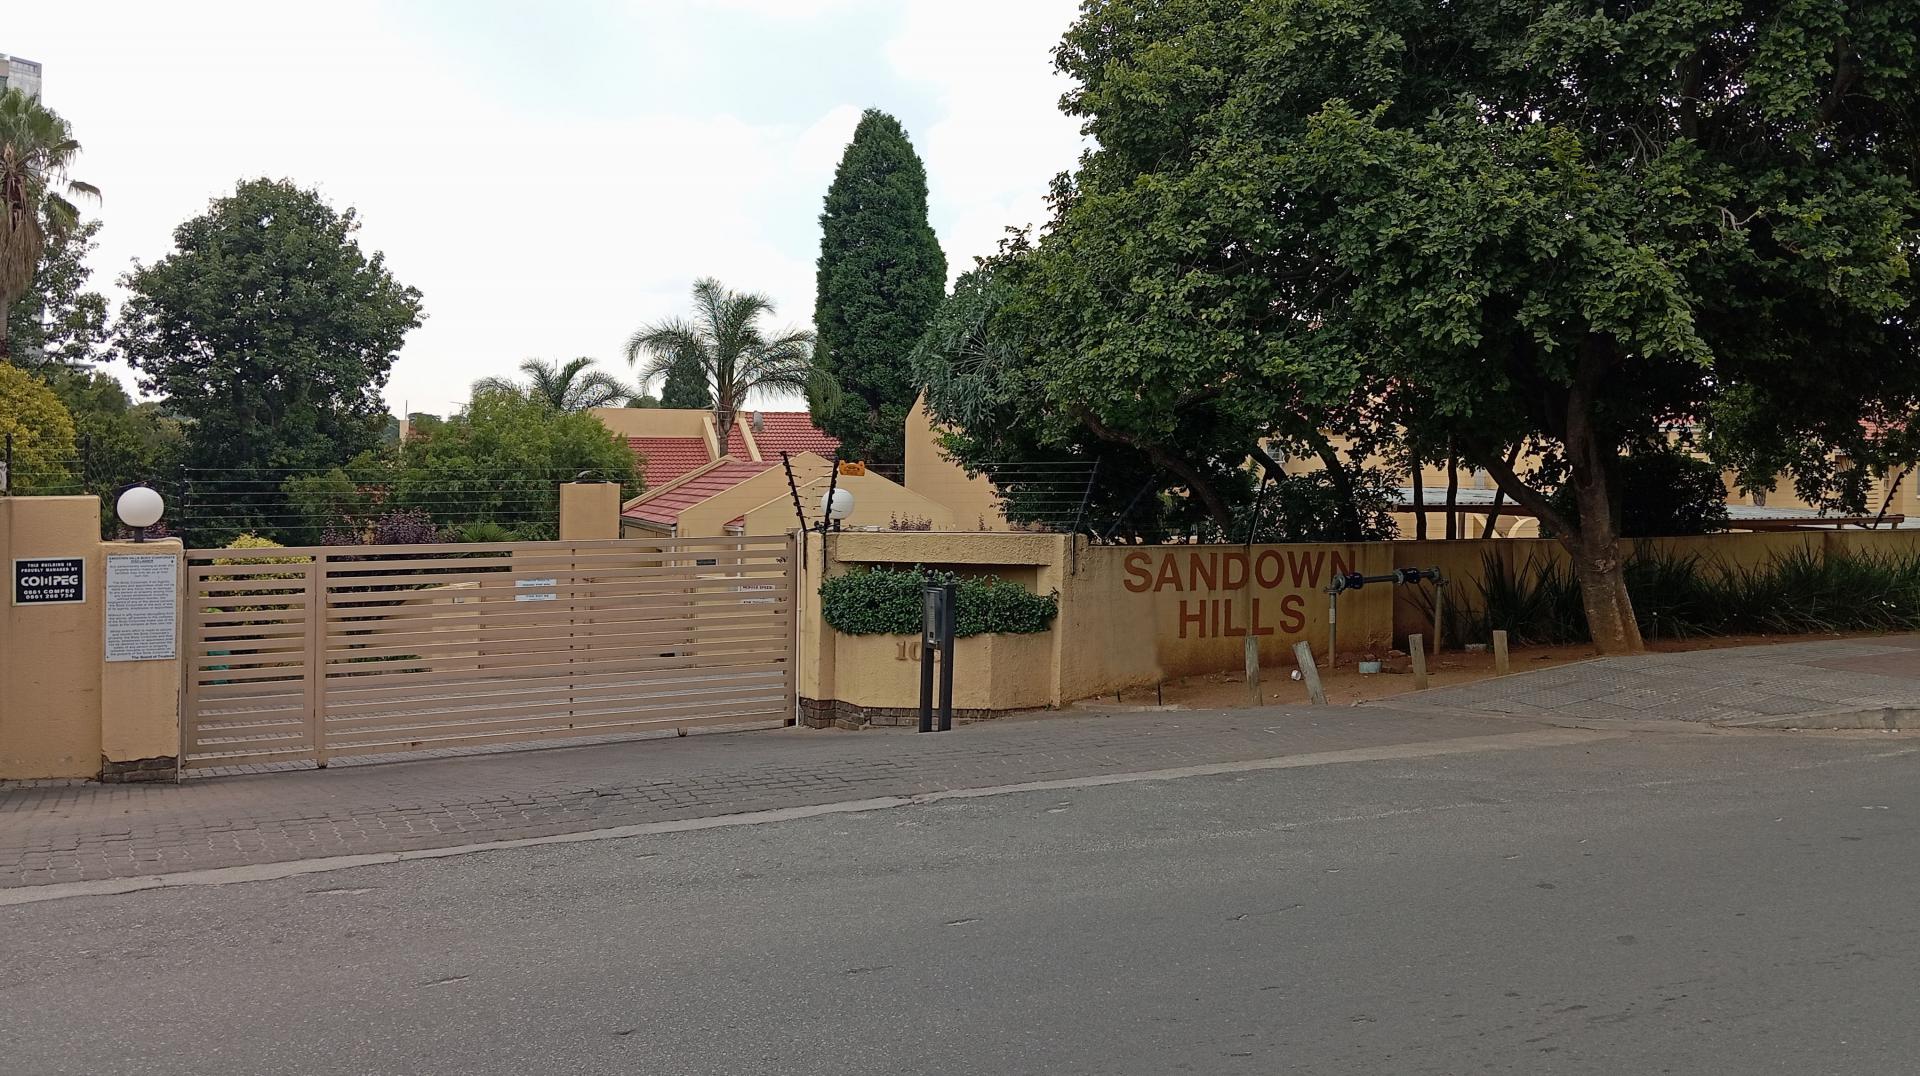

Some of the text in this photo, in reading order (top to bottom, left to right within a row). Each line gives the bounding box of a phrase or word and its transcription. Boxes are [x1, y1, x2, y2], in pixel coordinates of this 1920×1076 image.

[21, 575, 78, 586] COMPEG
[1123, 550, 1356, 593] SANDOWN
[1178, 594, 1306, 639] HILLS
